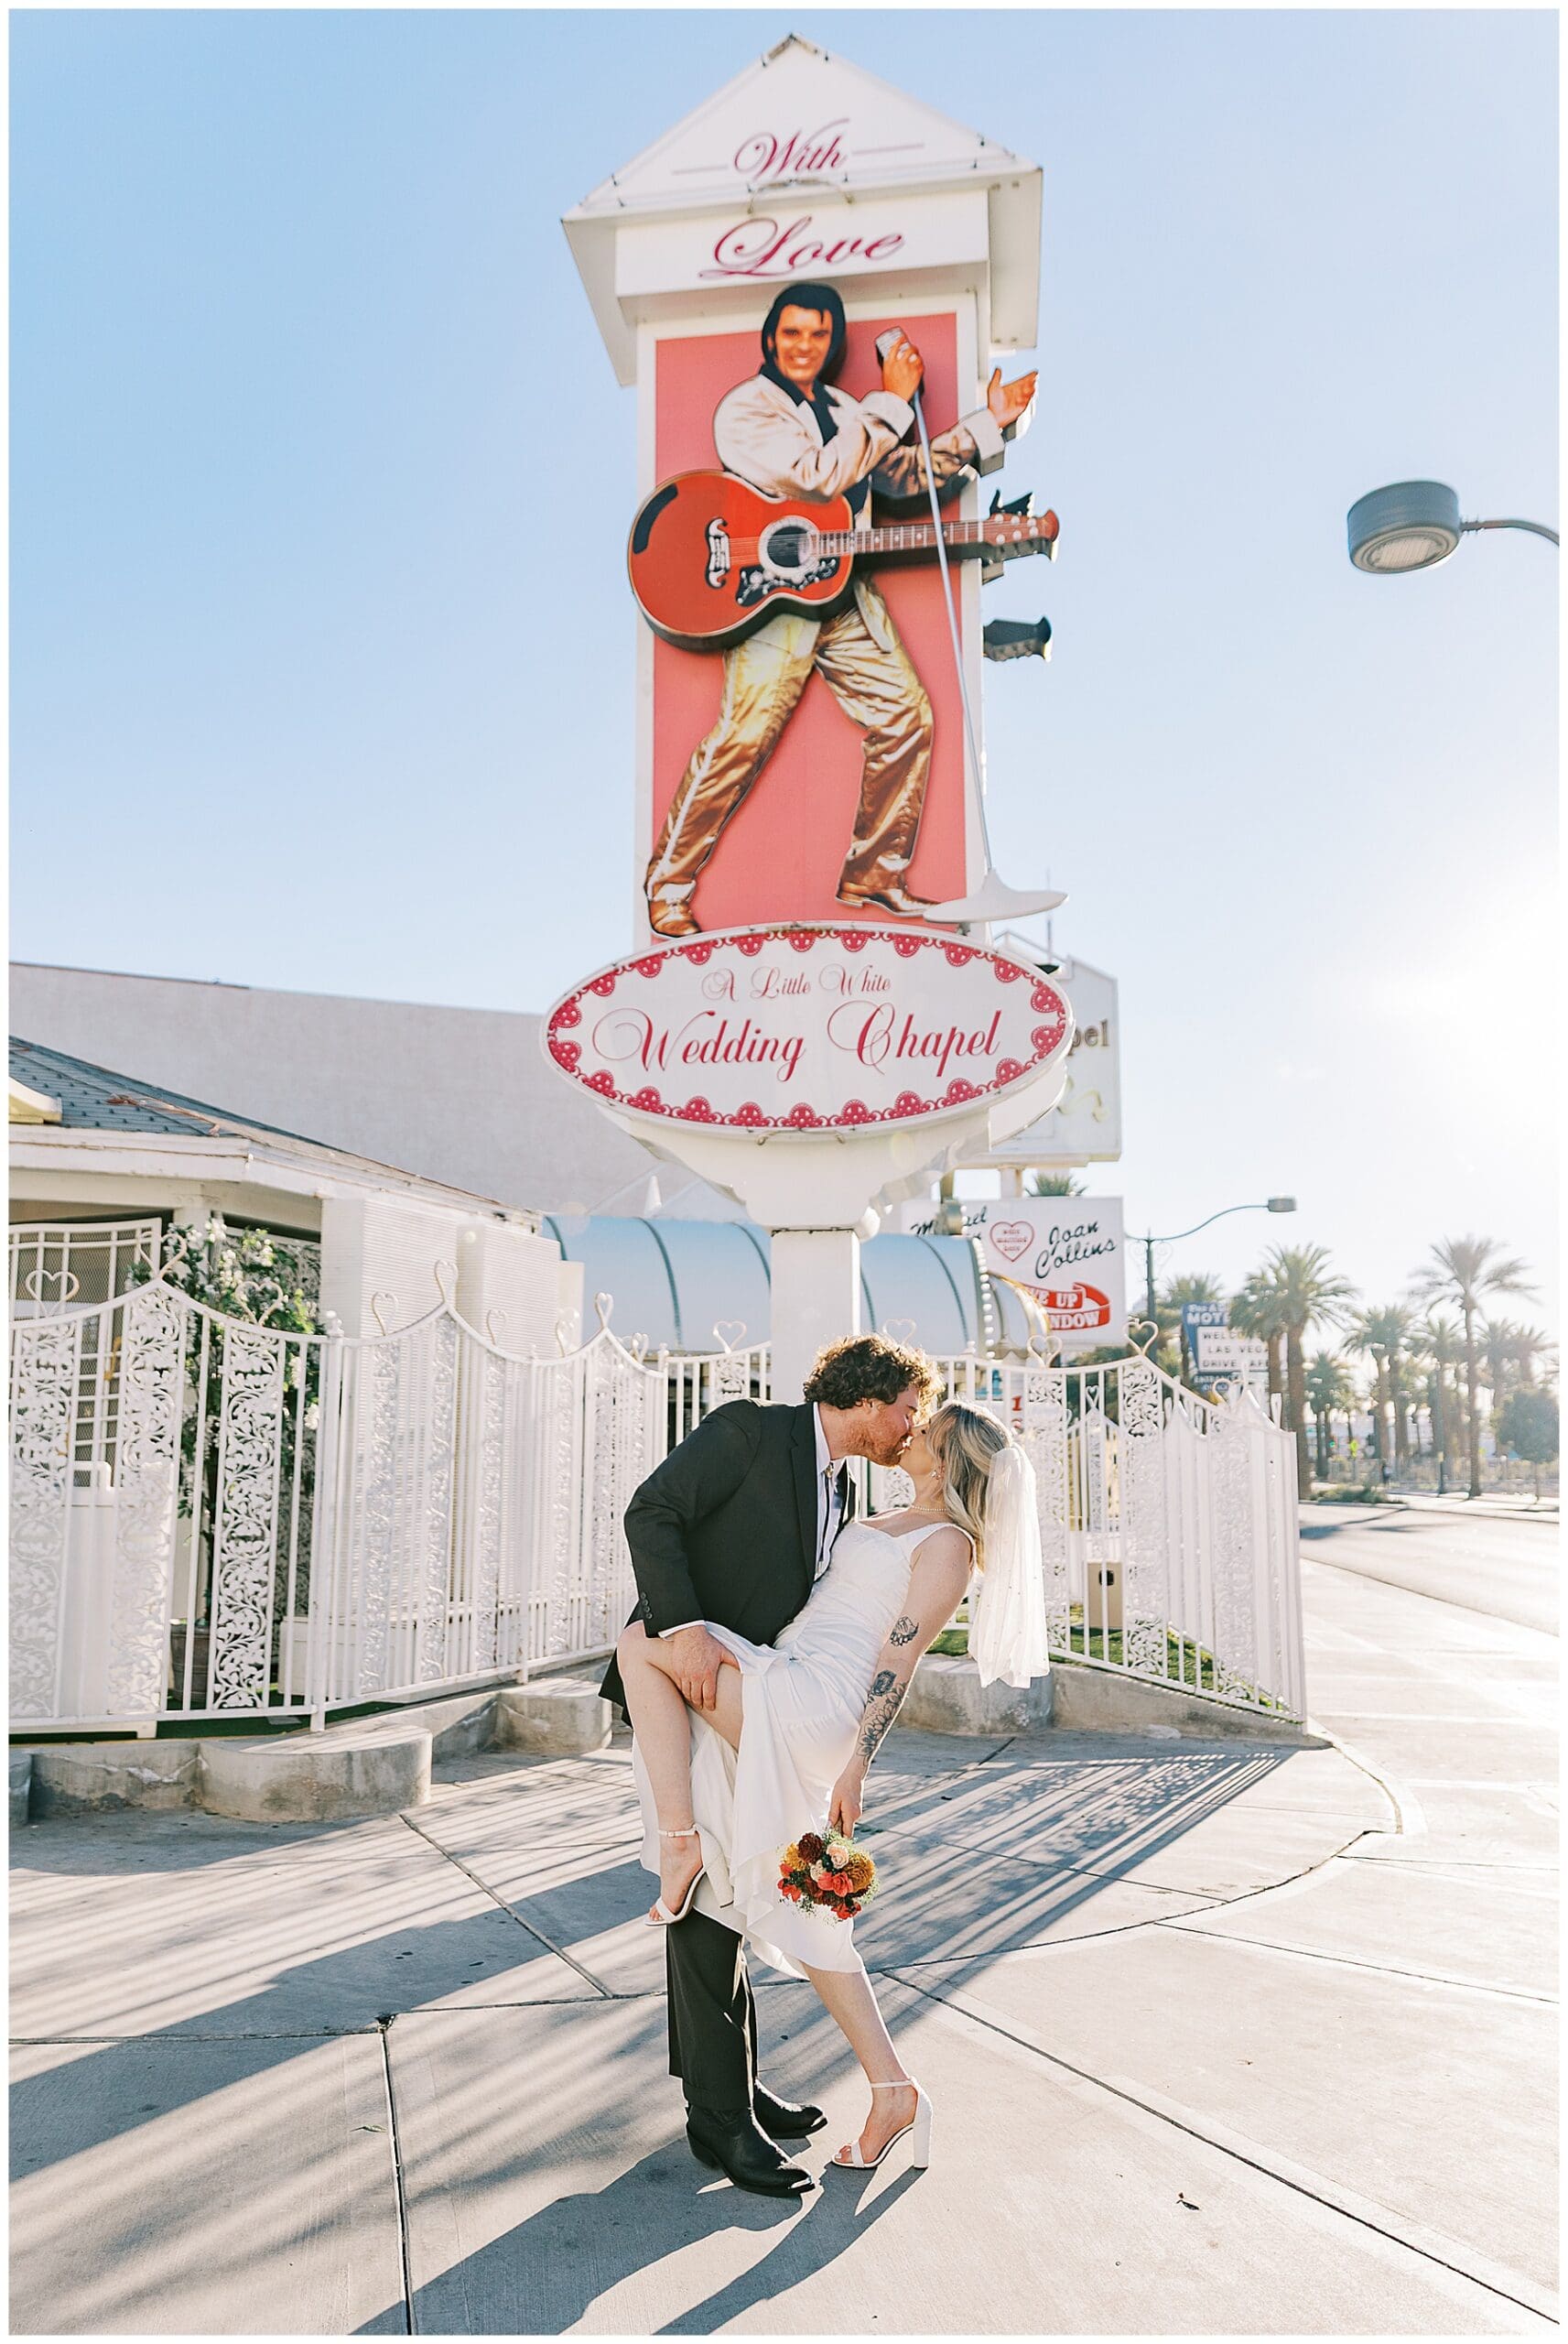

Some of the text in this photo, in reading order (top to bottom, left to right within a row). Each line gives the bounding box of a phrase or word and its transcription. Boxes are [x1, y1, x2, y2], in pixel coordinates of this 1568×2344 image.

[733, 118, 849, 180] With
[697, 215, 905, 278] Love
[701, 962, 892, 1003] A Little White
[592, 1000, 1004, 1082] Wedding Chapel
[1070, 1018, 1110, 1058] pel
[1048, 1219, 1098, 1256] Joan
[1035, 1237, 1117, 1279] Collins
[1050, 1311, 1100, 1329] NDOW
[1055, 1292, 1078, 1308] UP
[1186, 1312, 1230, 1325] MOTE
[1208, 1345, 1269, 1353] LAS VEGA
